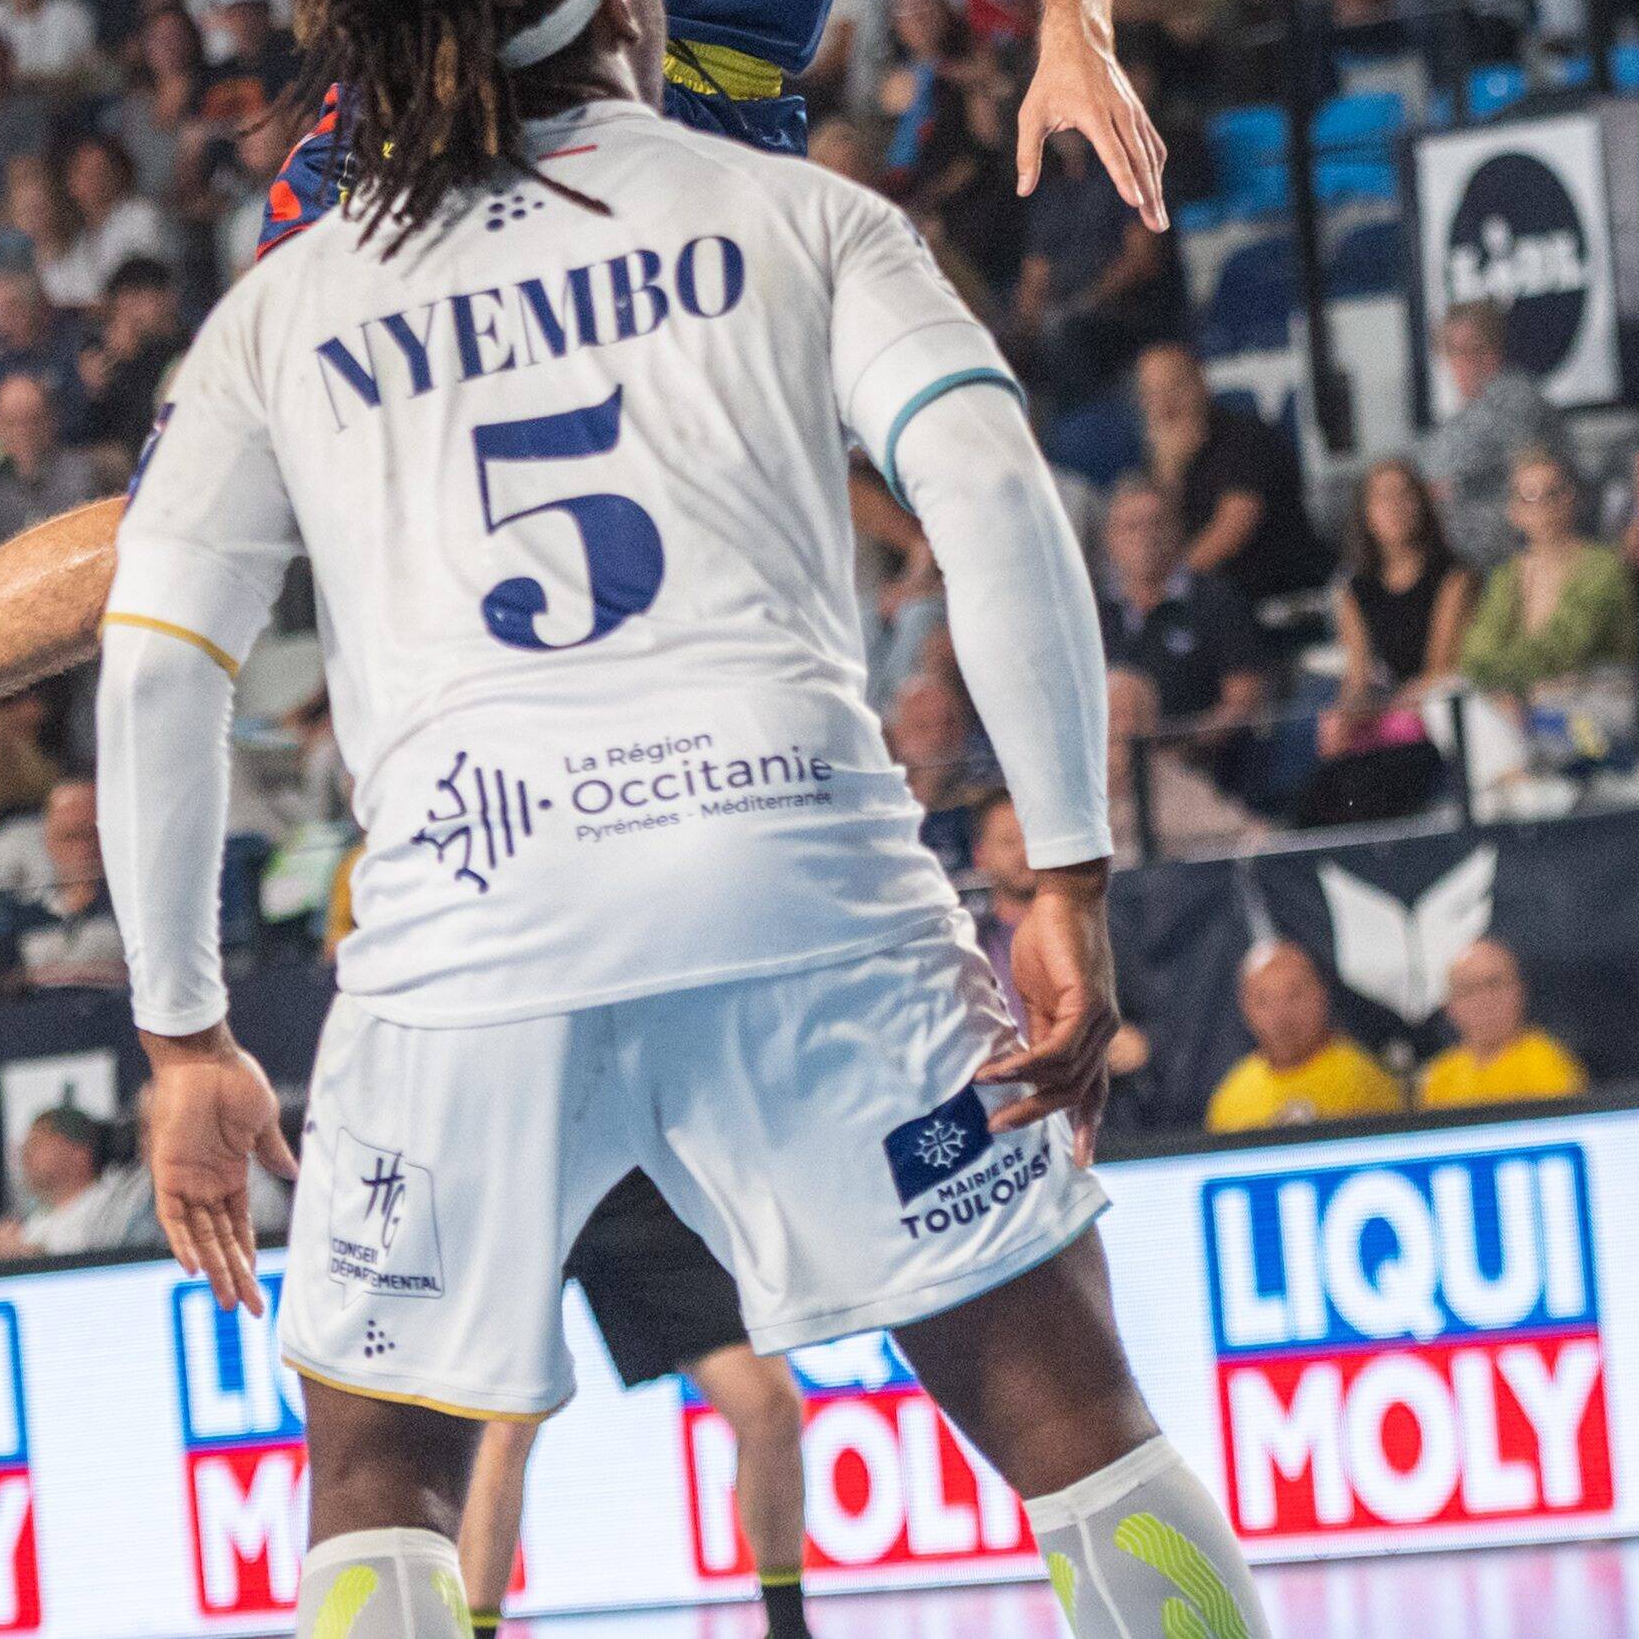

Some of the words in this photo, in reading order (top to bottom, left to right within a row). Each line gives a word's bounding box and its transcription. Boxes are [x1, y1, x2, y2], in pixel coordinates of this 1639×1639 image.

[314, 234, 745, 432] NYEMBO
[471, 382, 664, 653] 5
[565, 755, 597, 774] La
[607, 733, 713, 767] Région
[572, 745, 833, 814] Occitanie
[576, 811, 680, 842] Pyrénées
[937, 1163, 1000, 1203] MAIRIE
[1003, 1147, 1024, 1169] DE
[1210, 1154, 1590, 1346] LIQUI
[1224, 1336, 1604, 1532] MOLY
